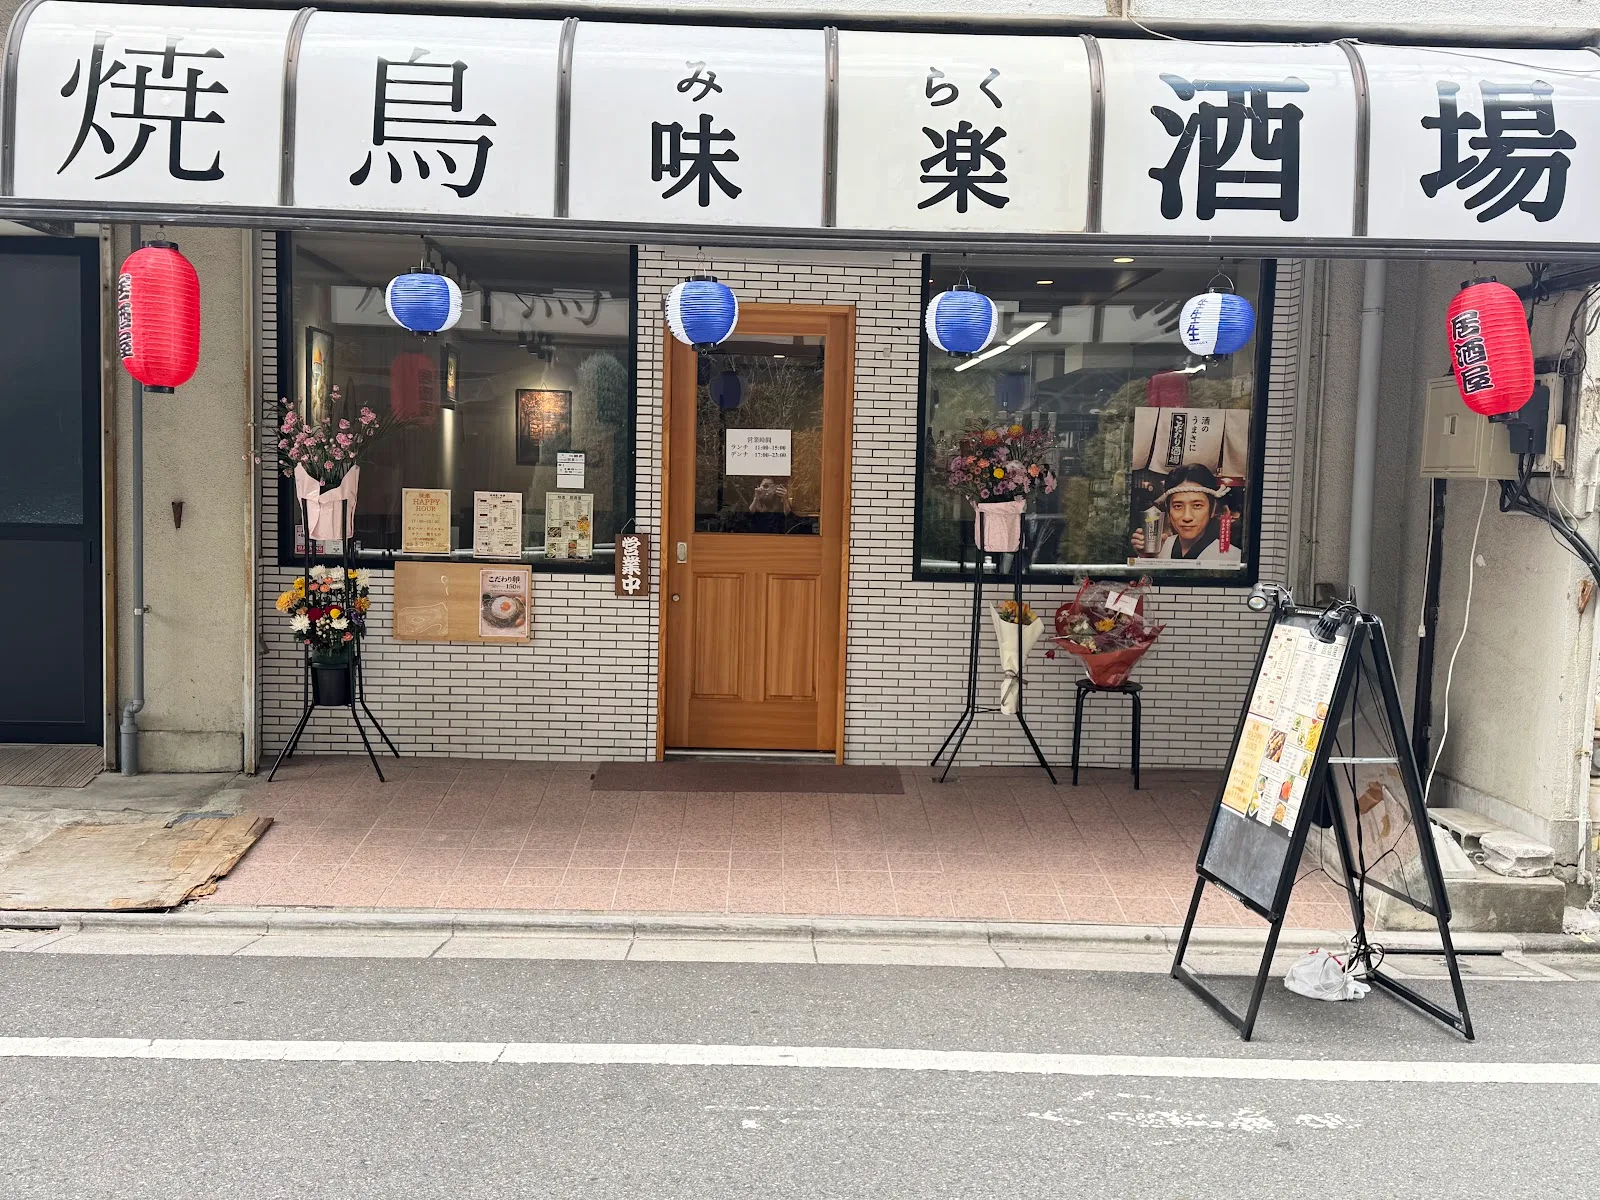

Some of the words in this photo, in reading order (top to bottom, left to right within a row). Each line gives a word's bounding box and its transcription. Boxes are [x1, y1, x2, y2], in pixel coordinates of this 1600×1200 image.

[677, 60, 723, 102] み
[924, 66, 1005, 109] らく
[57, 29, 497, 198] 焼鳥
[651, 112, 1010, 213] 味楽
[1148, 72, 1577, 223] 酒場
[1450, 309, 1496, 395] 居酒屋
[1169, 415, 1185, 464] こだわり酒場
[1189, 415, 1198, 452] うまさに
[1201, 416, 1211, 433] 酒の
[488, 575, 520, 584] こだわり卵
[621, 536, 642, 595] 営業中
